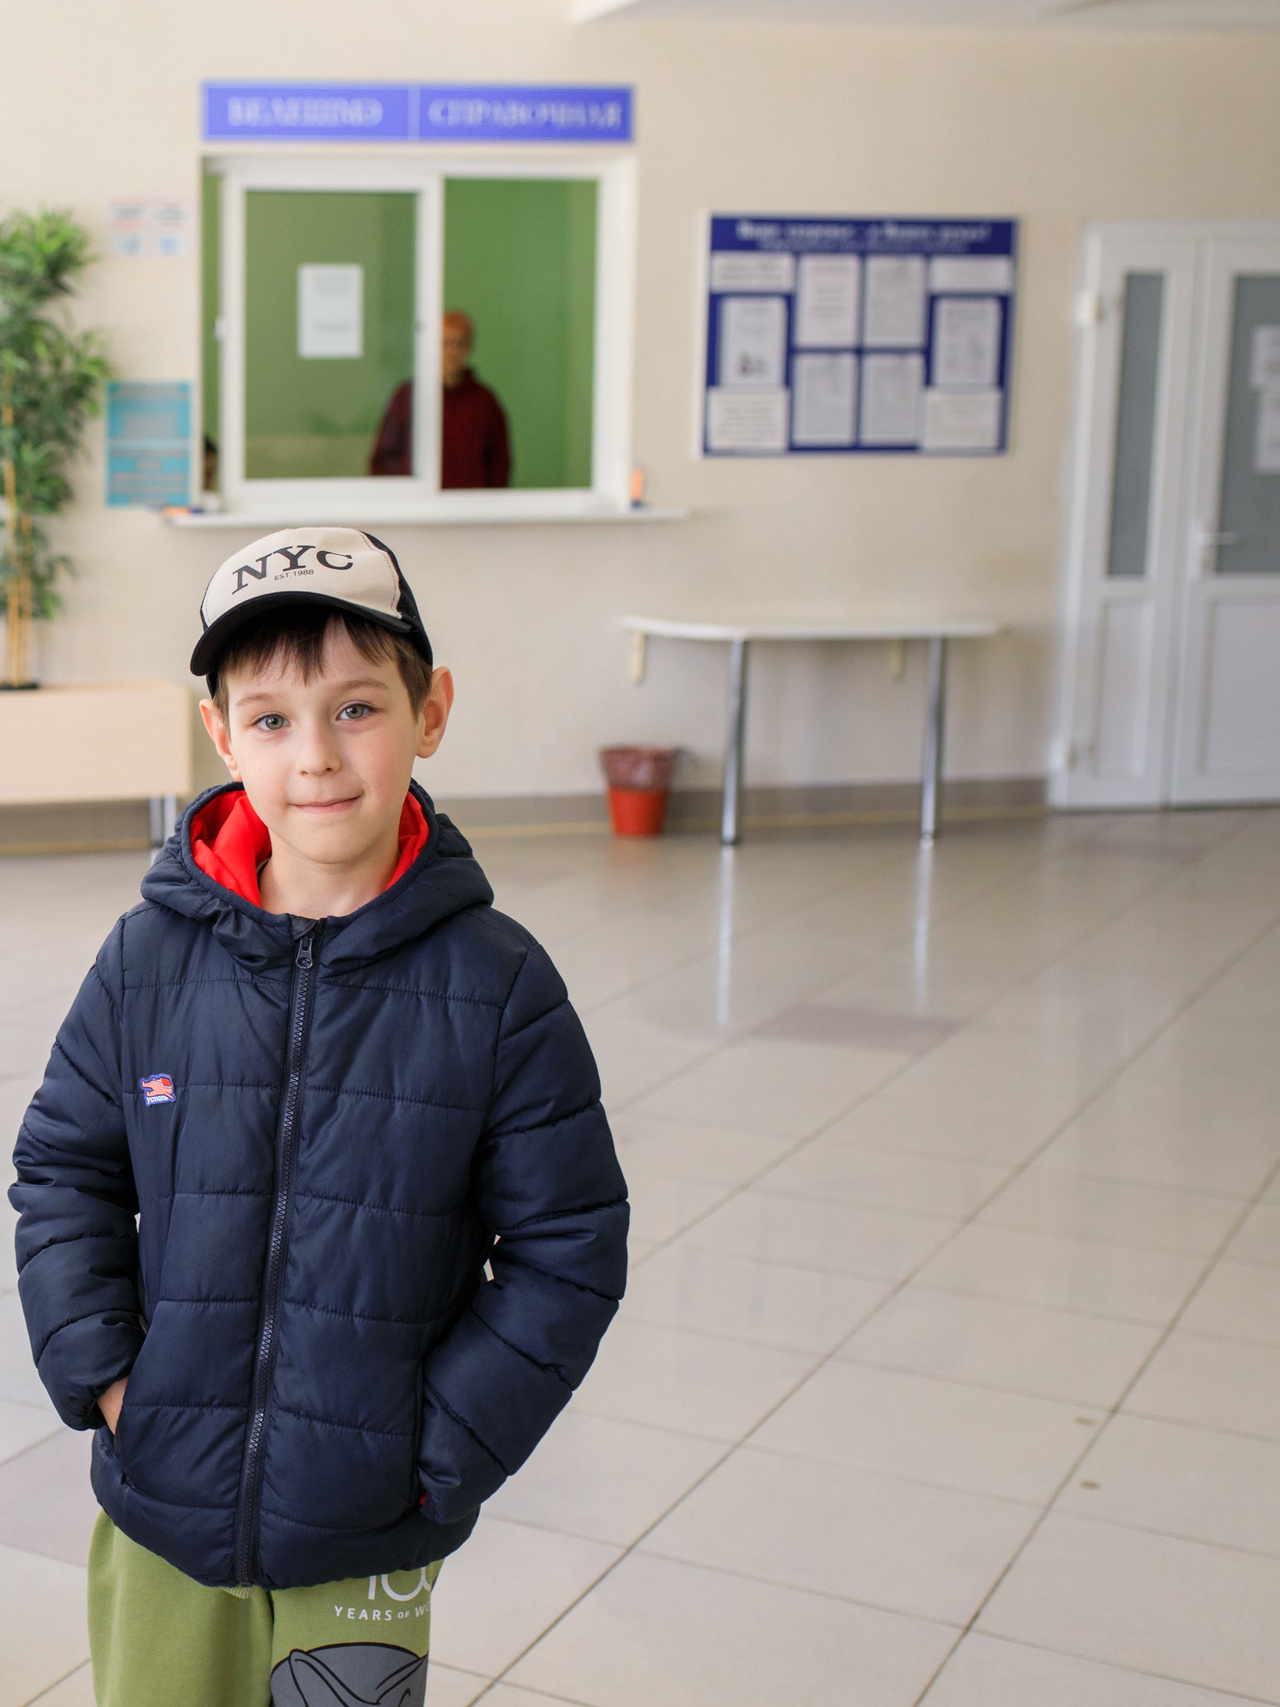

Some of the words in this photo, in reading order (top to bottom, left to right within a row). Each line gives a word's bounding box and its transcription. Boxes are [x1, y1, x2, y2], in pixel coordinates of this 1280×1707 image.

[232, 545, 353, 594] NYC
[333, 1605, 393, 1621] YEARS
[397, 1611, 411, 1619] OF
